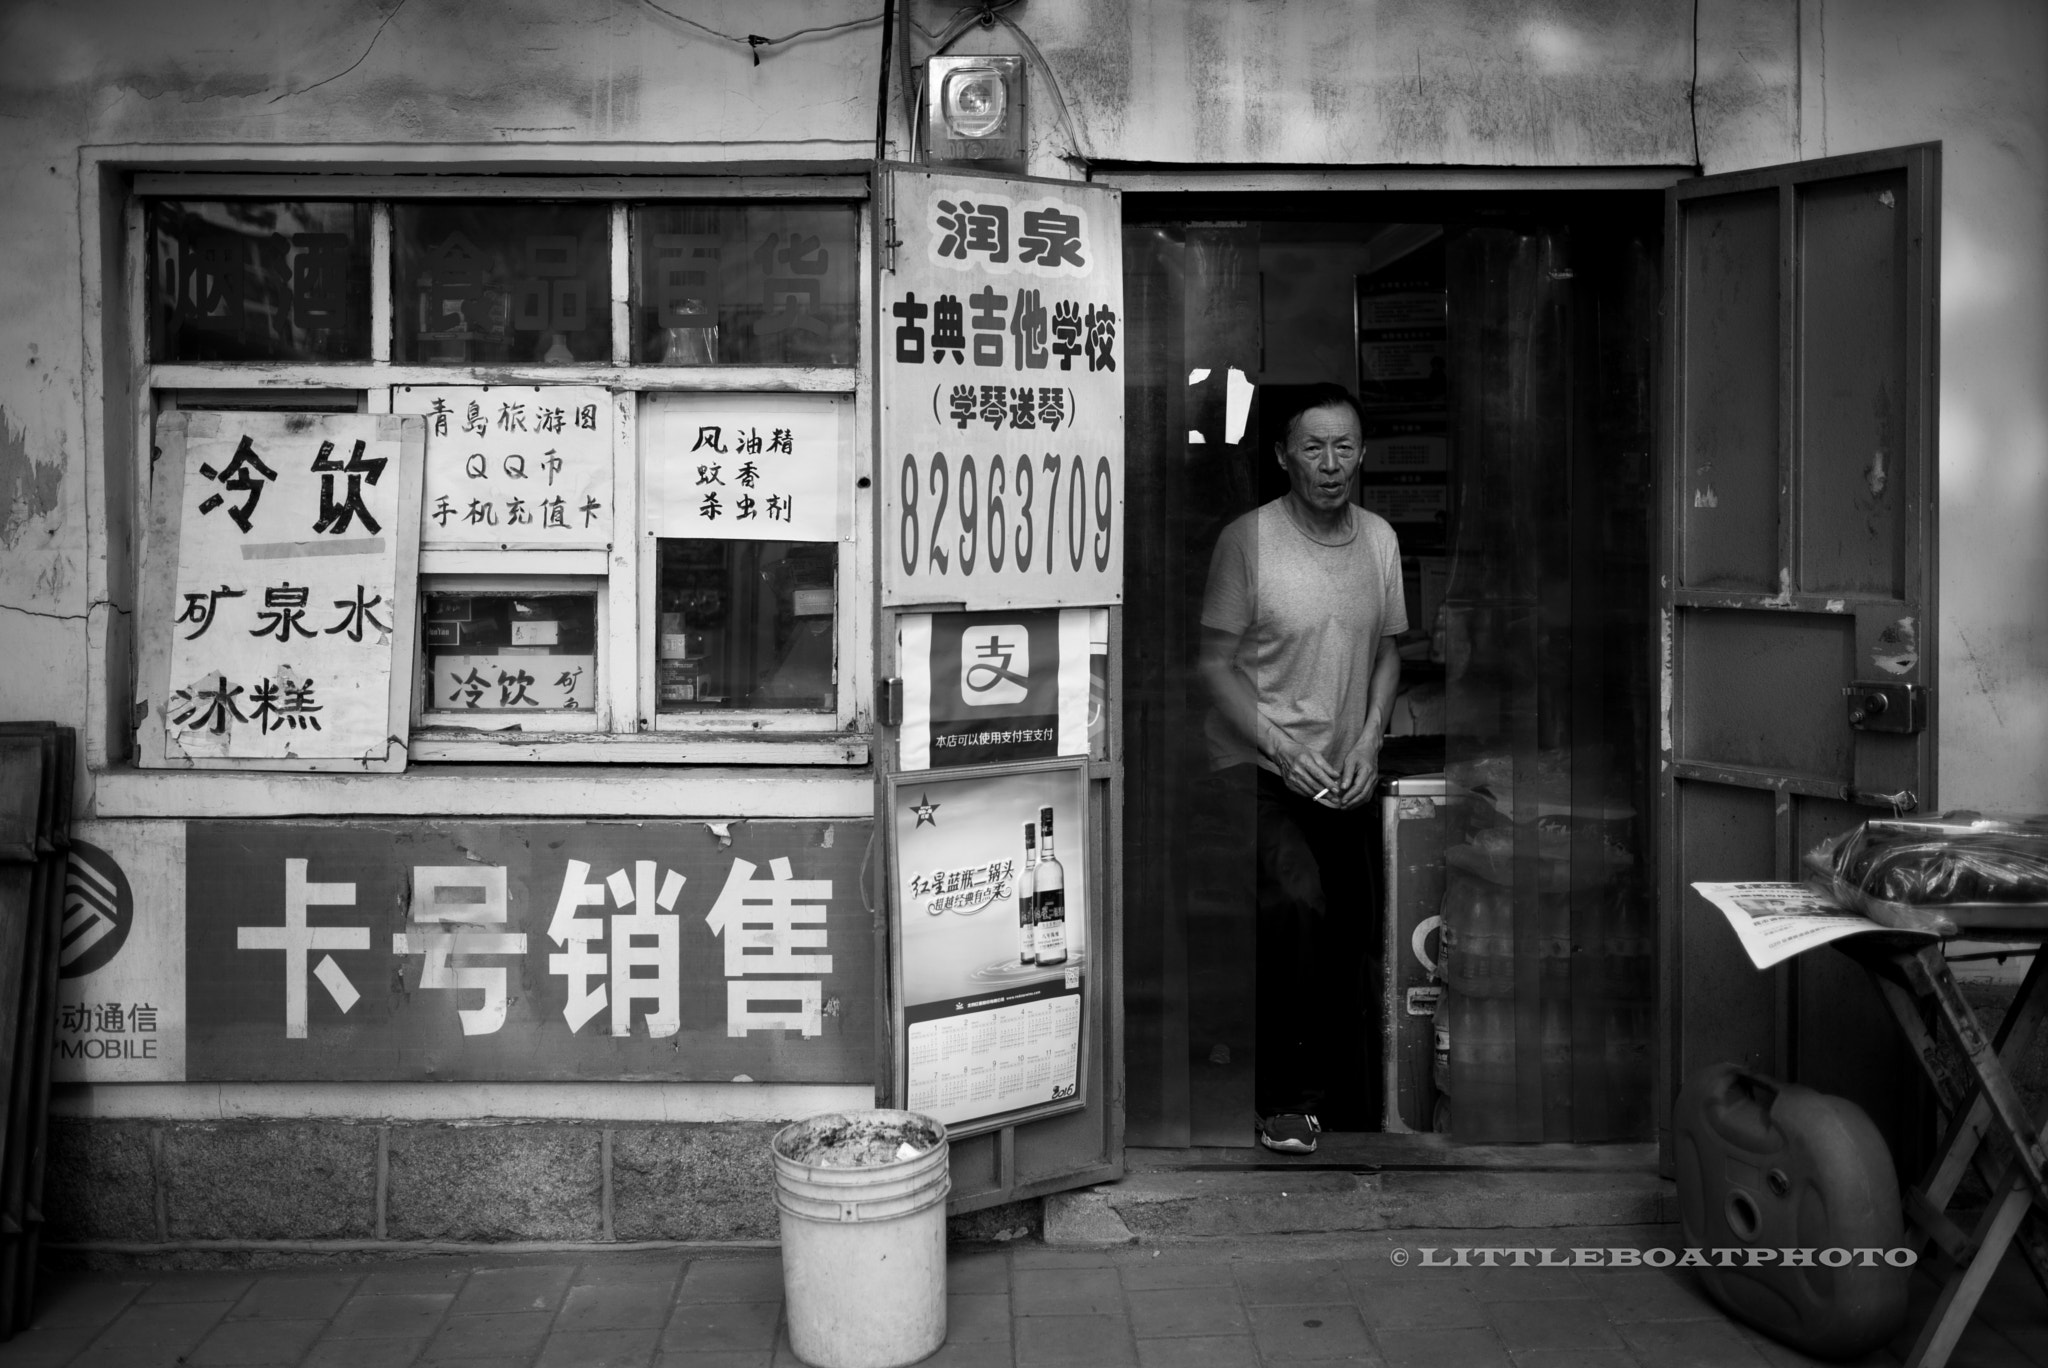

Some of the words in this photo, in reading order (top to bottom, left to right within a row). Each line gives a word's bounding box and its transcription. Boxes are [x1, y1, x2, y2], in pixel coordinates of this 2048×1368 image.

[936, 199, 1086, 268] 润泉
[167, 232, 348, 333] 烟酒
[422, 230, 586, 331] 食品
[653, 232, 830, 335] 百货
[893, 285, 1116, 372] 古典吉他学校
[690, 426, 795, 456] 风油精
[199, 435, 388, 535] 冷饮
[466, 449, 563, 486] QQ币
[695, 461, 760, 490] 蚊香
[431, 494, 601, 529] 手机充值卡
[698, 492, 792, 525] 杀虫剂
[900, 451, 1112, 577] 82963709
[176, 582, 393, 642] 矿泉水
[172, 677, 323, 735] 冰糕
[449, 667, 539, 708] 冷饮
[935, 728, 1053, 748] 本店可以使用支付宝支付
[911, 860, 1014, 898] 红星蓝瓶二锅头
[935, 881, 1006, 910] 超越经典有点柔
[237, 856, 834, 1039] 卡号销售
[56, 1002, 158, 1034] 动通信
[61, 1039, 157, 1059] MOBILE
